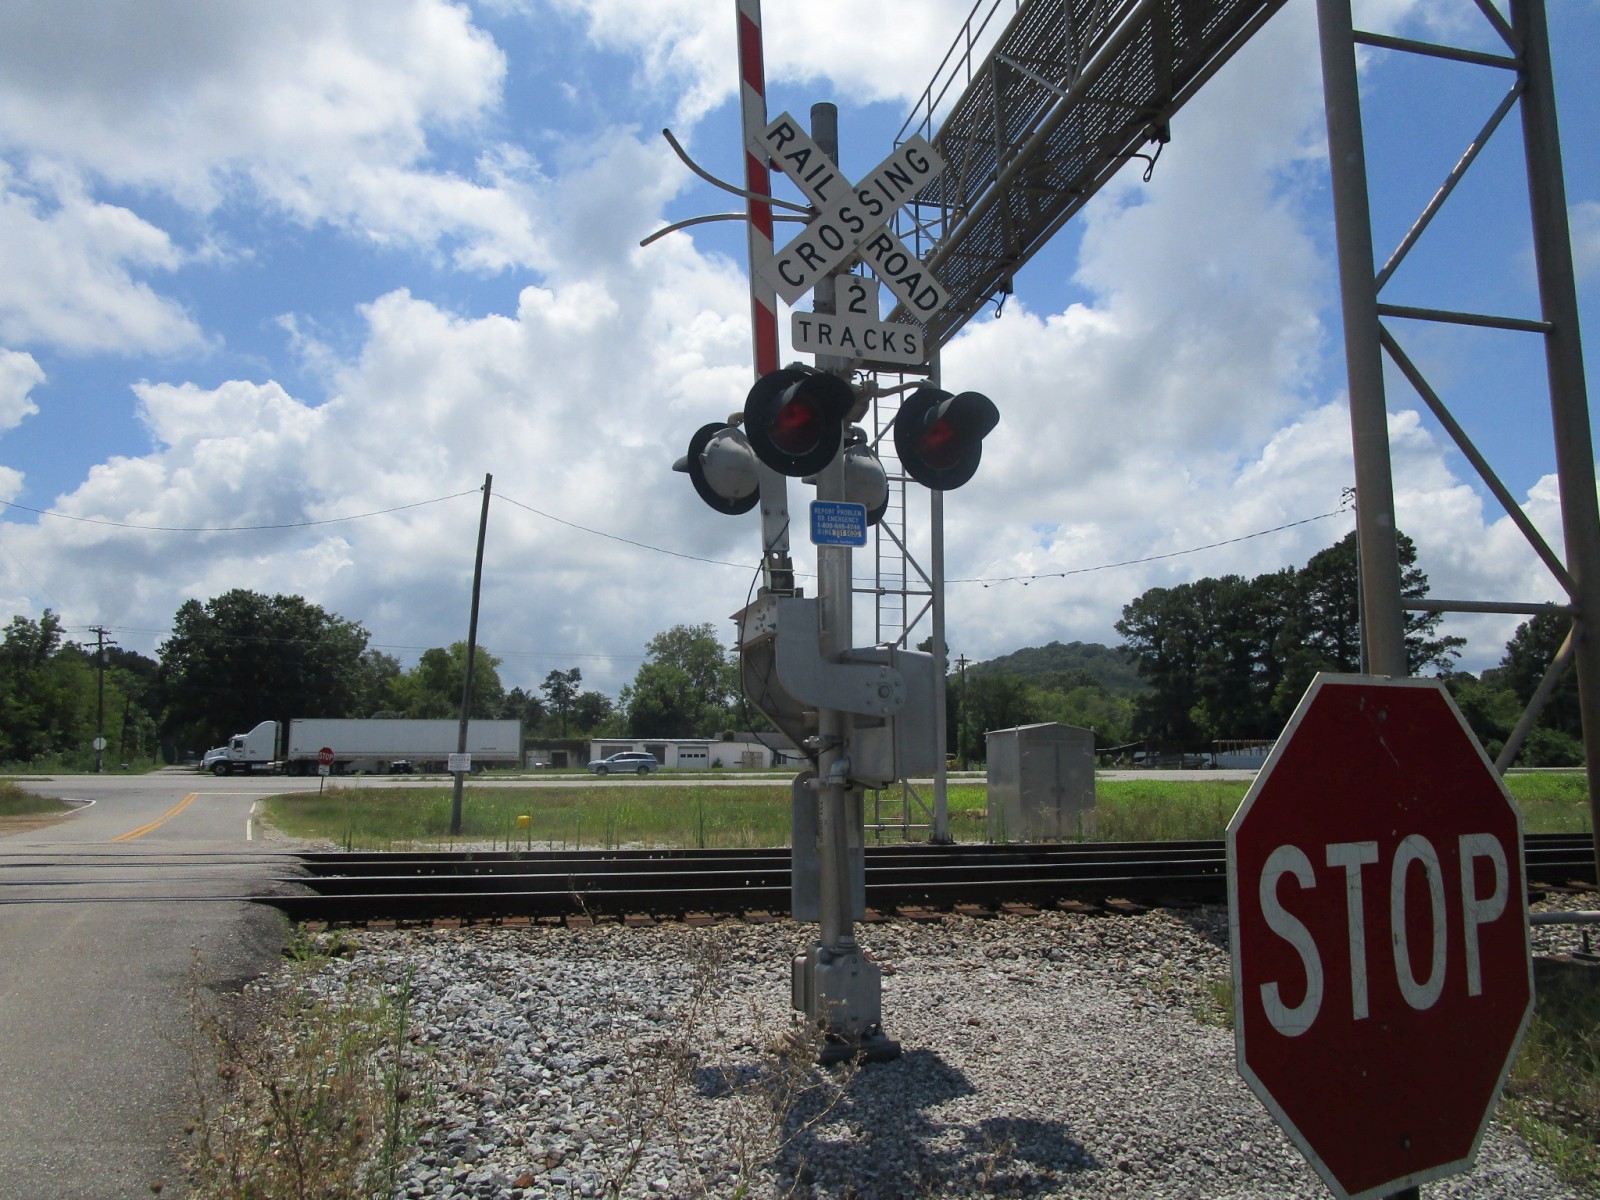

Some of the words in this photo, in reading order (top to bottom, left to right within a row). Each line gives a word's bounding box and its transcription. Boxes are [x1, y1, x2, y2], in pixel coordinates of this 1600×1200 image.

[766, 121, 834, 202] RAIL
[866, 232, 939, 311] ROAD
[777, 148, 930, 287] CROSSING
[847, 285, 867, 314] 2
[798, 320, 917, 355] TRACKS
[814, 507, 835, 515] REPORT
[836, 509, 862, 517] PROBLEM
[827, 515, 860, 524] EMERGENCY
[319, 752, 334, 760] STOP
[1259, 833, 1509, 1037] STOP
